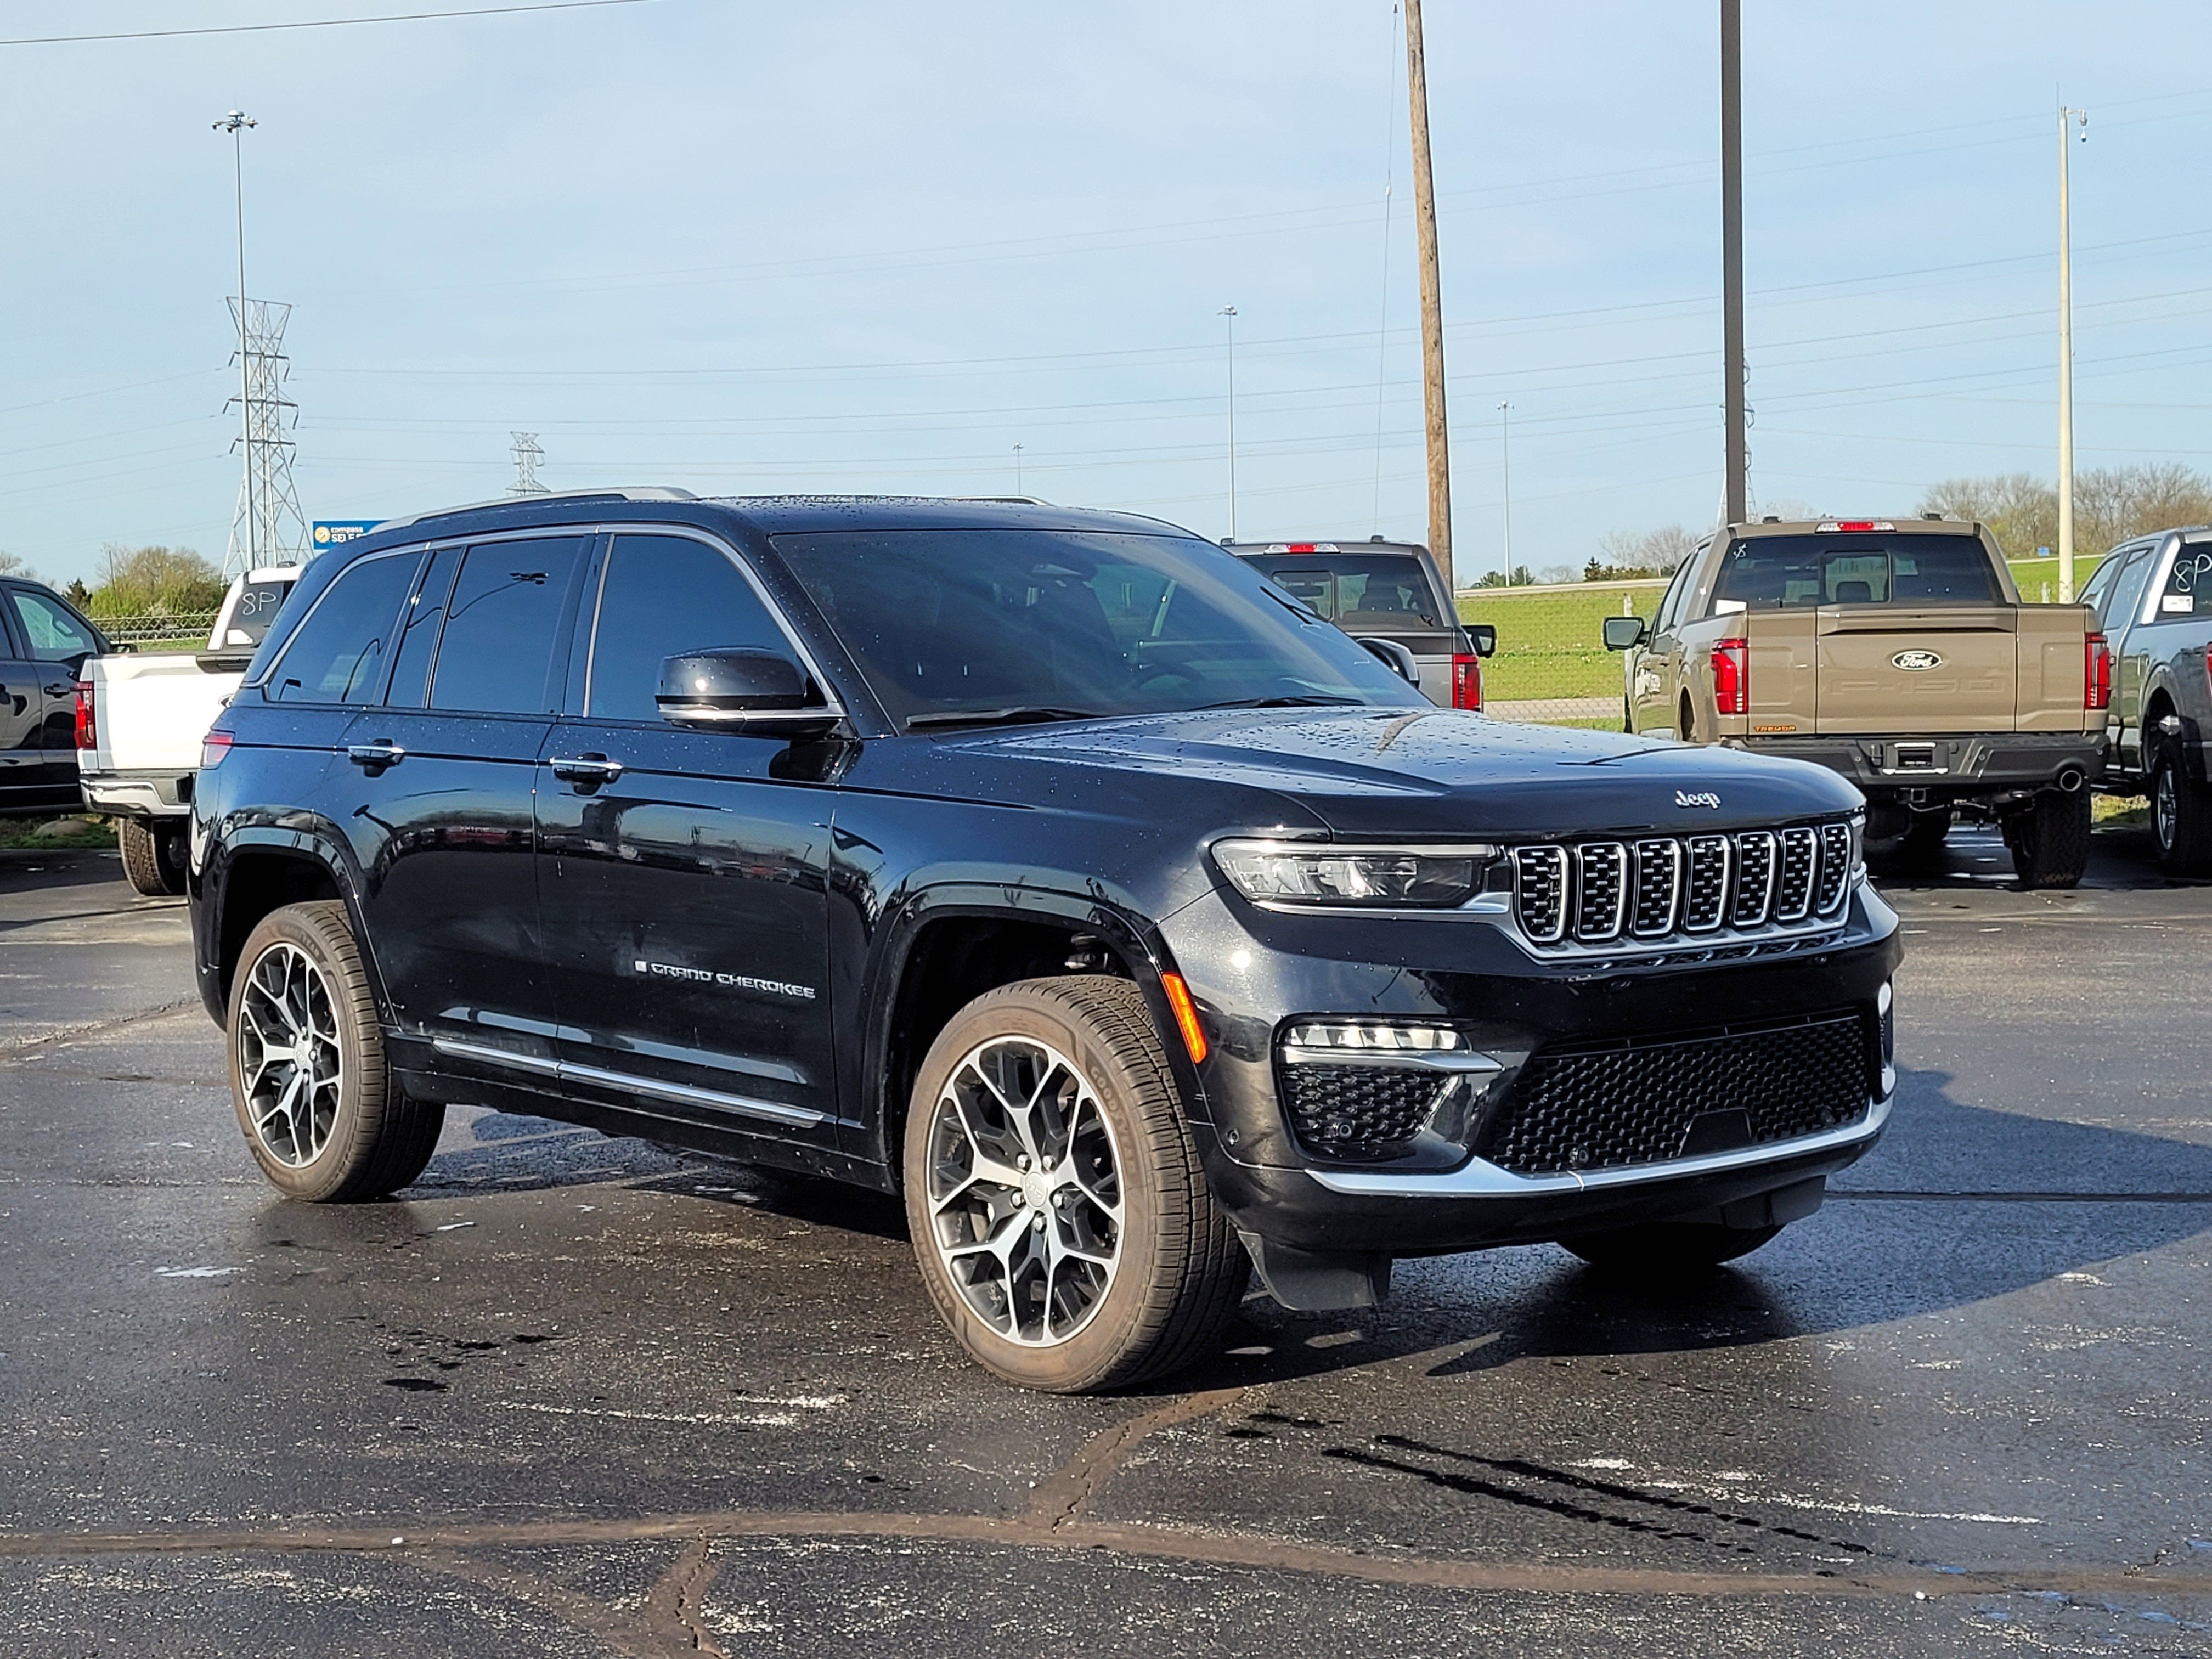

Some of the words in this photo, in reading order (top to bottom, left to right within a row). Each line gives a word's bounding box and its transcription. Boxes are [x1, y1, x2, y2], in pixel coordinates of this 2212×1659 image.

[1900, 654, 1933, 667] Ford
[1675, 790, 1722, 809] Jeep
[650, 962, 712, 981] GRAND
[716, 973, 816, 1000] CHEROKEE
